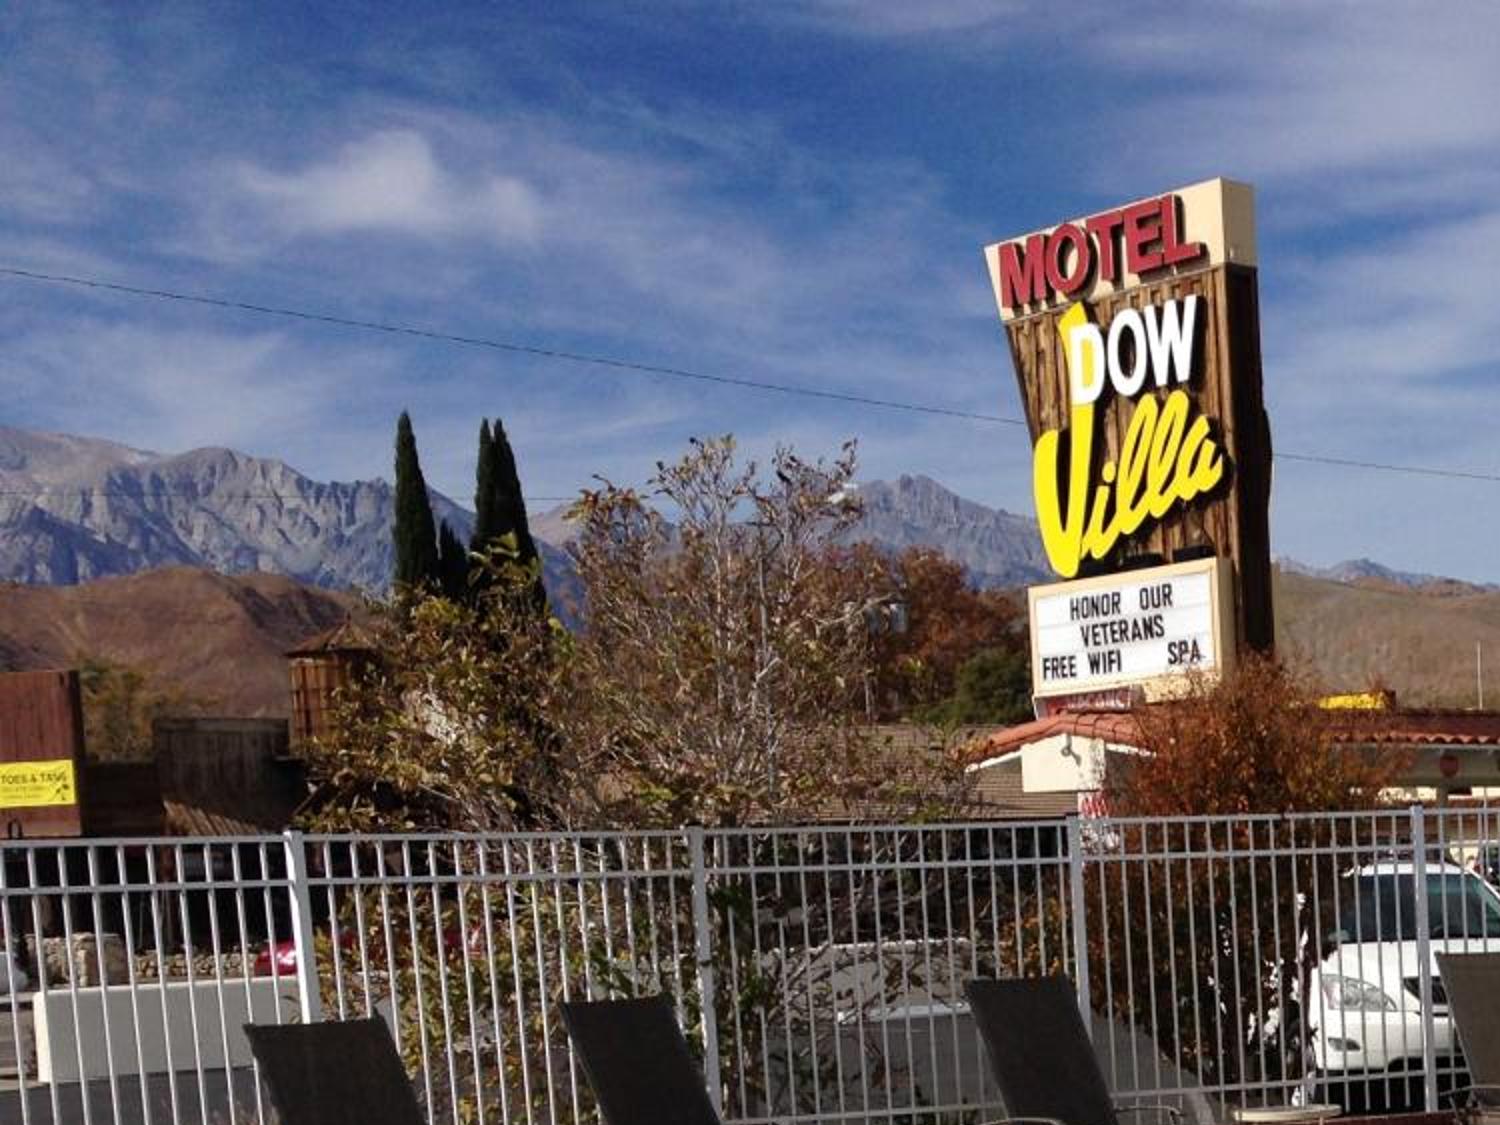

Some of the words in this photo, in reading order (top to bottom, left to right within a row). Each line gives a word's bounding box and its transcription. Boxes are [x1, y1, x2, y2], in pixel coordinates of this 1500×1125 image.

[999, 195, 1201, 307] MOTEL
[1069, 294, 1197, 405] DOW
[1033, 303, 1224, 579] Villa
[1069, 591, 1121, 621] HONOR
[1138, 583, 1173, 610] OUR
[1080, 614, 1165, 647] VETERANS
[1042, 655, 1077, 680] FREE
[1087, 648, 1122, 675] WIFI
[1167, 638, 1202, 666] SPA
